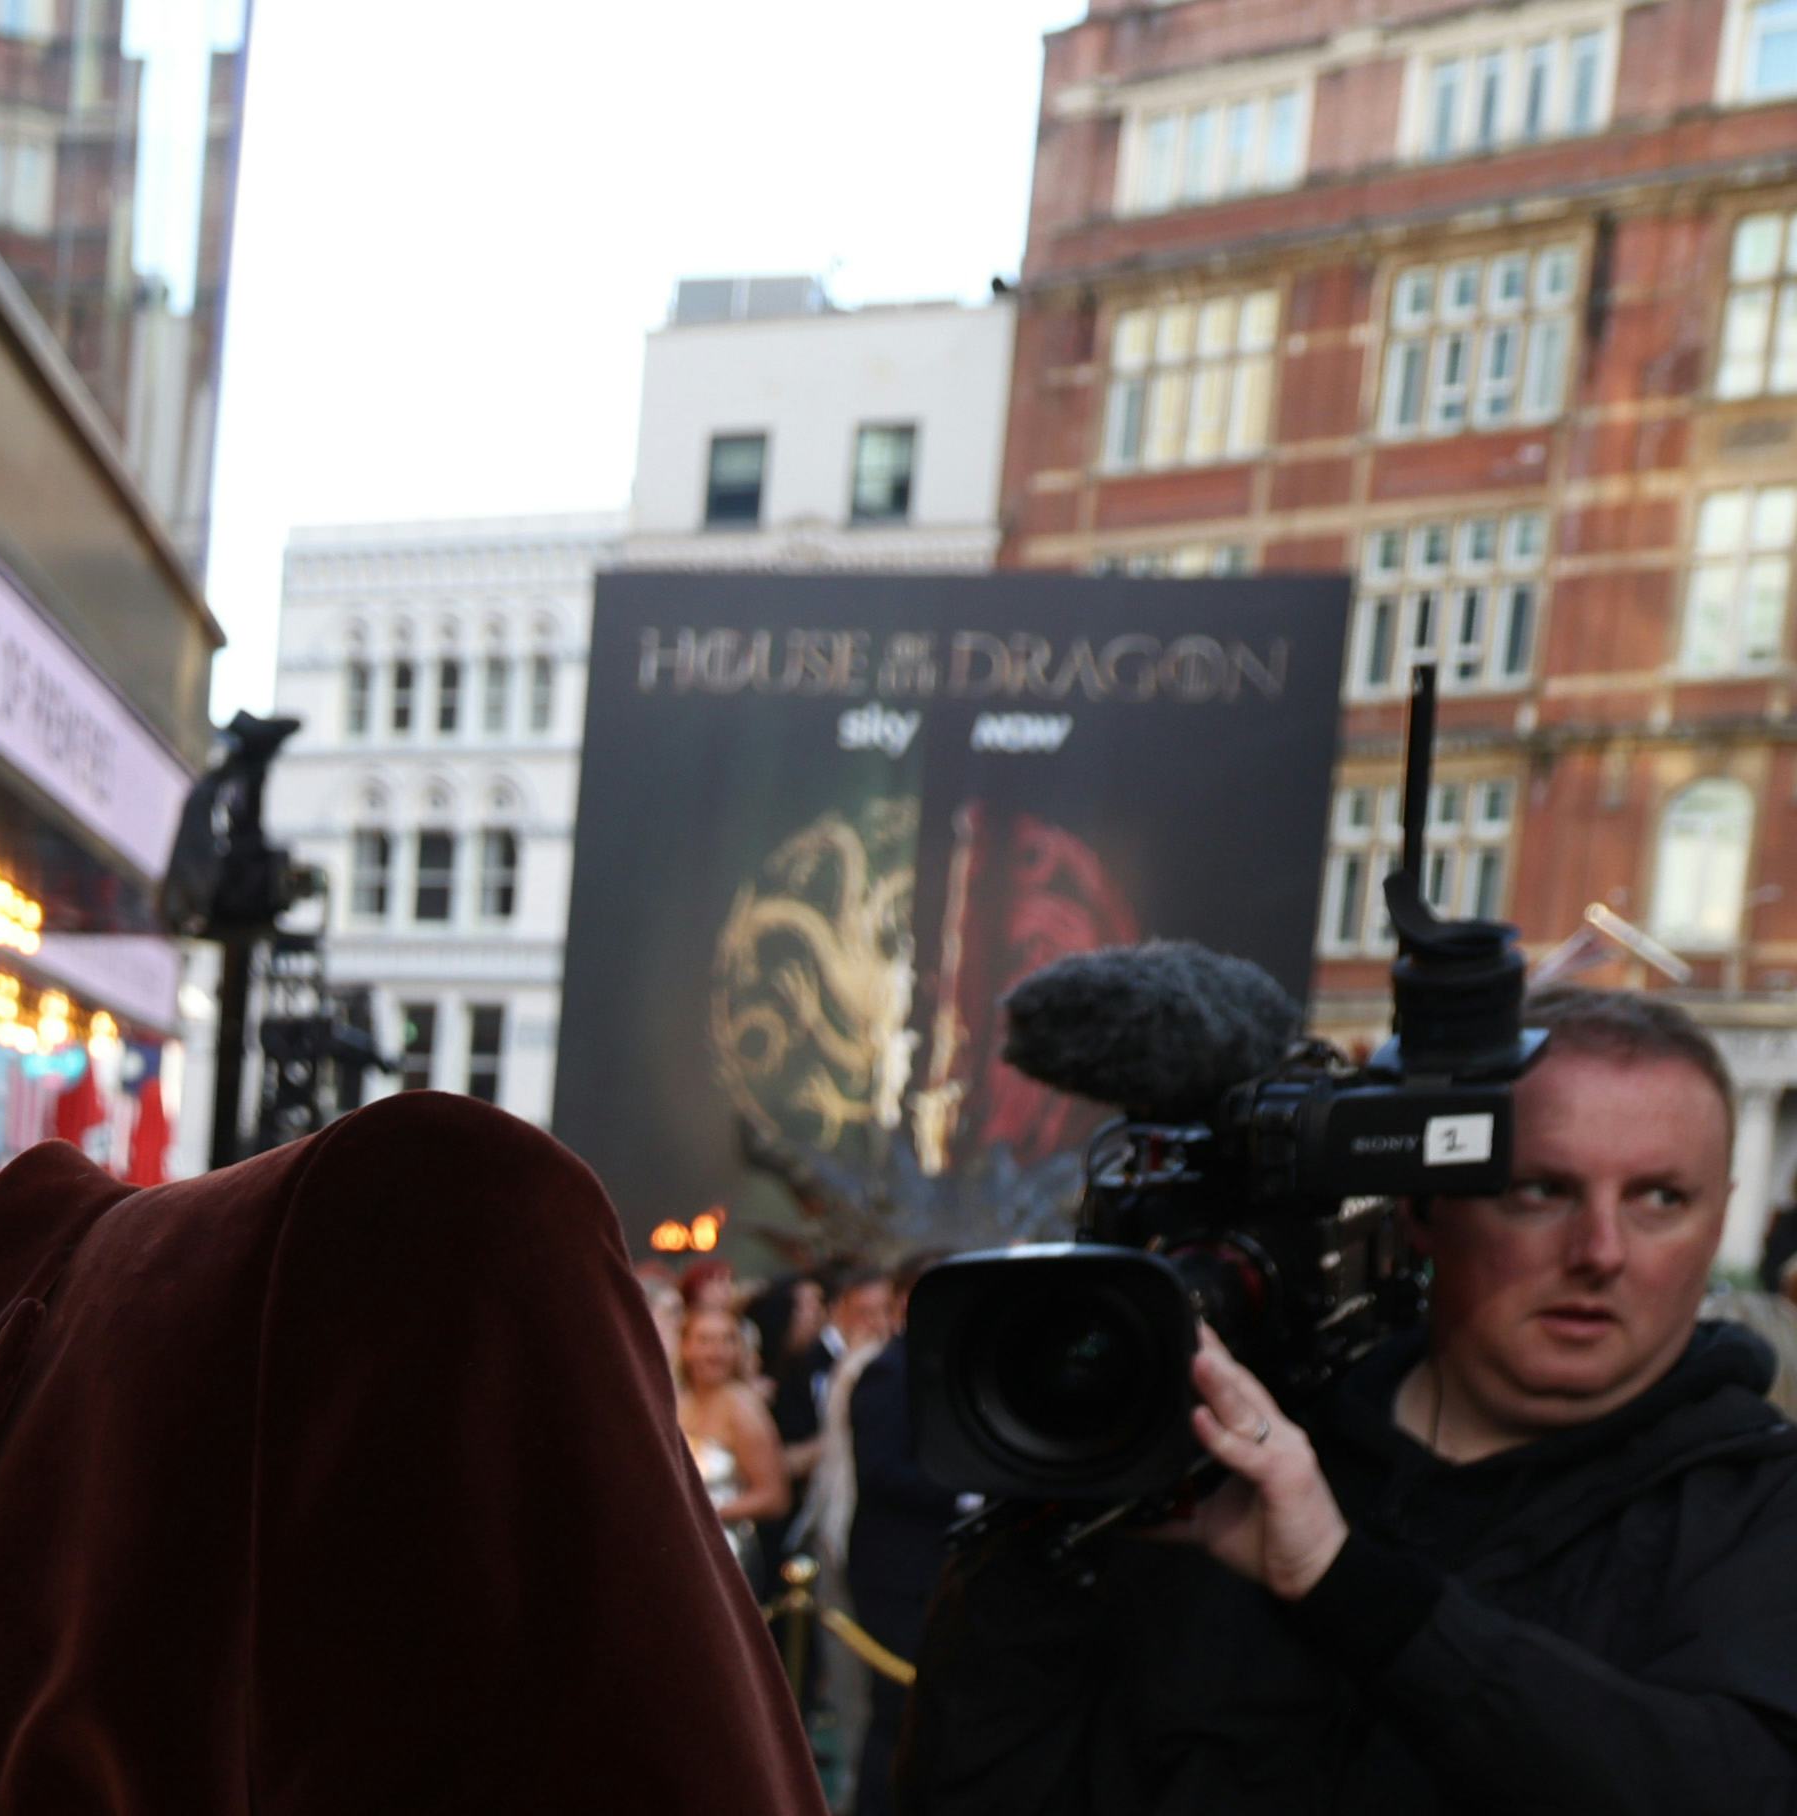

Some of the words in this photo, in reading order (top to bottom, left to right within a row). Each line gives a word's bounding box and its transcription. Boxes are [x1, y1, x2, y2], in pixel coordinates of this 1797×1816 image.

[638, 627, 871, 696] HOUSE
[950, 629, 1292, 701] DRAGON
[838, 702, 921, 760] sky
